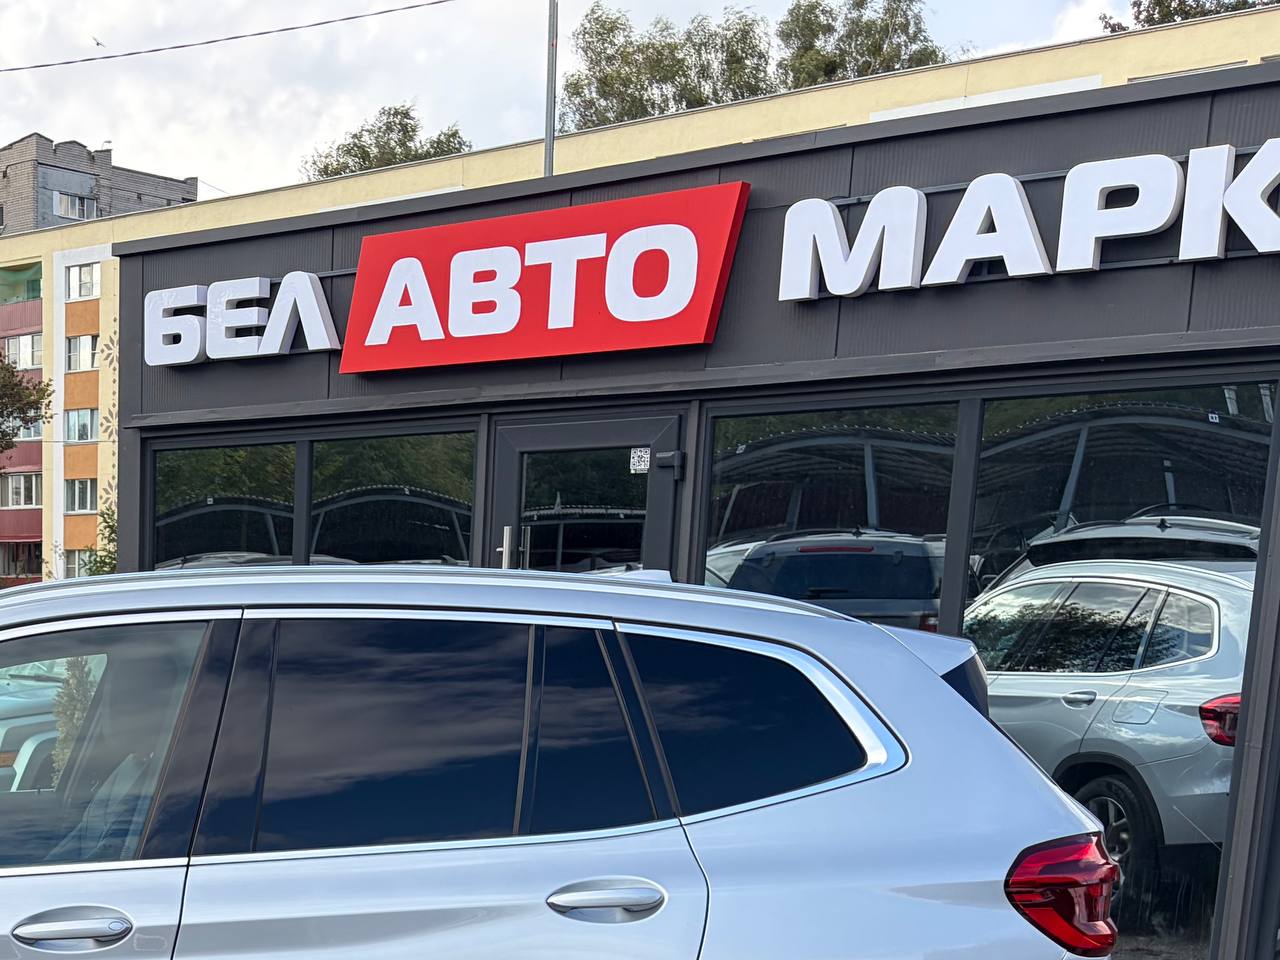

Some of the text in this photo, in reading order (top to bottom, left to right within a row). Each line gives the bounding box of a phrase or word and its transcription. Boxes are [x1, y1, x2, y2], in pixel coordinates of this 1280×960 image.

[144, 137, 1280, 366] БЕЛ АВТО МАРК
